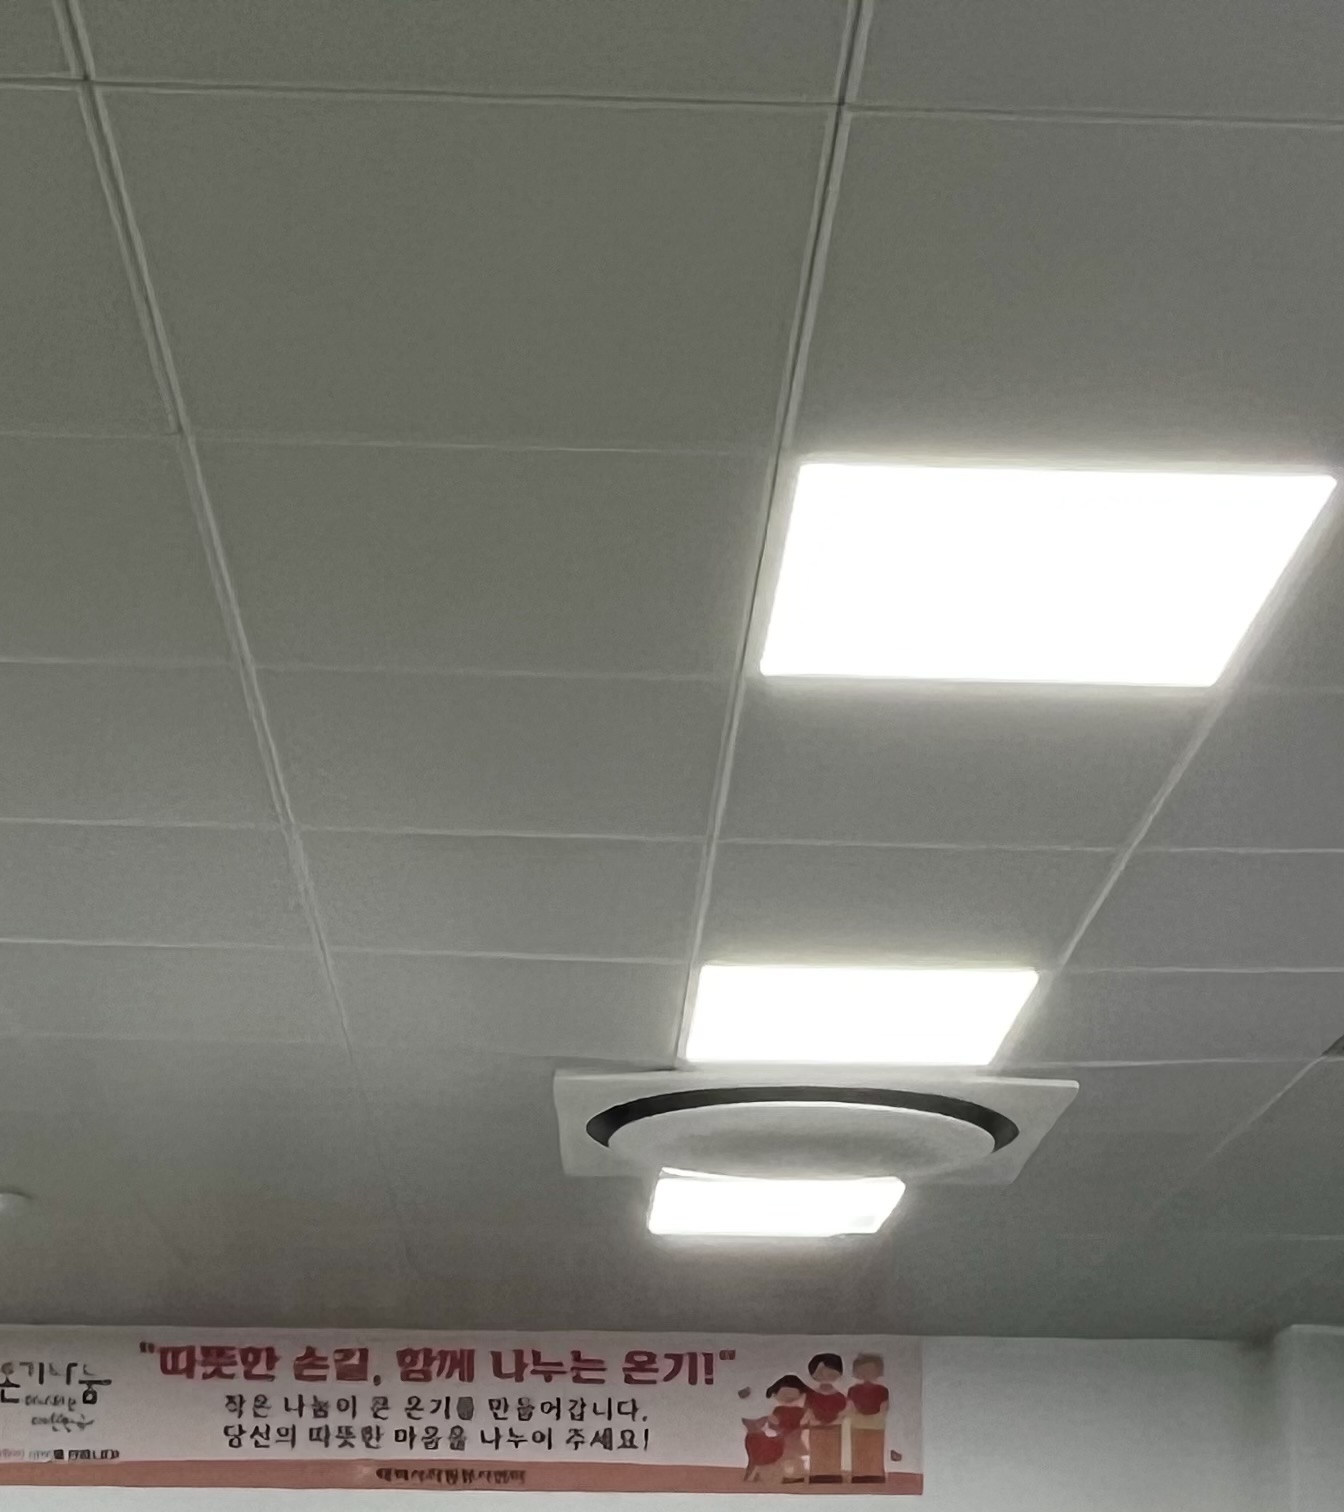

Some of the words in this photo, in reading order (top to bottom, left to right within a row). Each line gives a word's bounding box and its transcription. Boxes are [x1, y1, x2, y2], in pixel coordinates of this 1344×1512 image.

[293, 1346, 381, 1386] 손길,
[397, 1347, 475, 1384] 함께
[491, 1349, 607, 1385] 나누는
[224, 1393, 272, 1419] 작은
[284, 1394, 357, 1420] 나눔이
[223, 1424, 297, 1449] 당신의
[308, 1424, 383, 1450] 따뜻한
[565, 1427, 649, 1453] 주세요!
